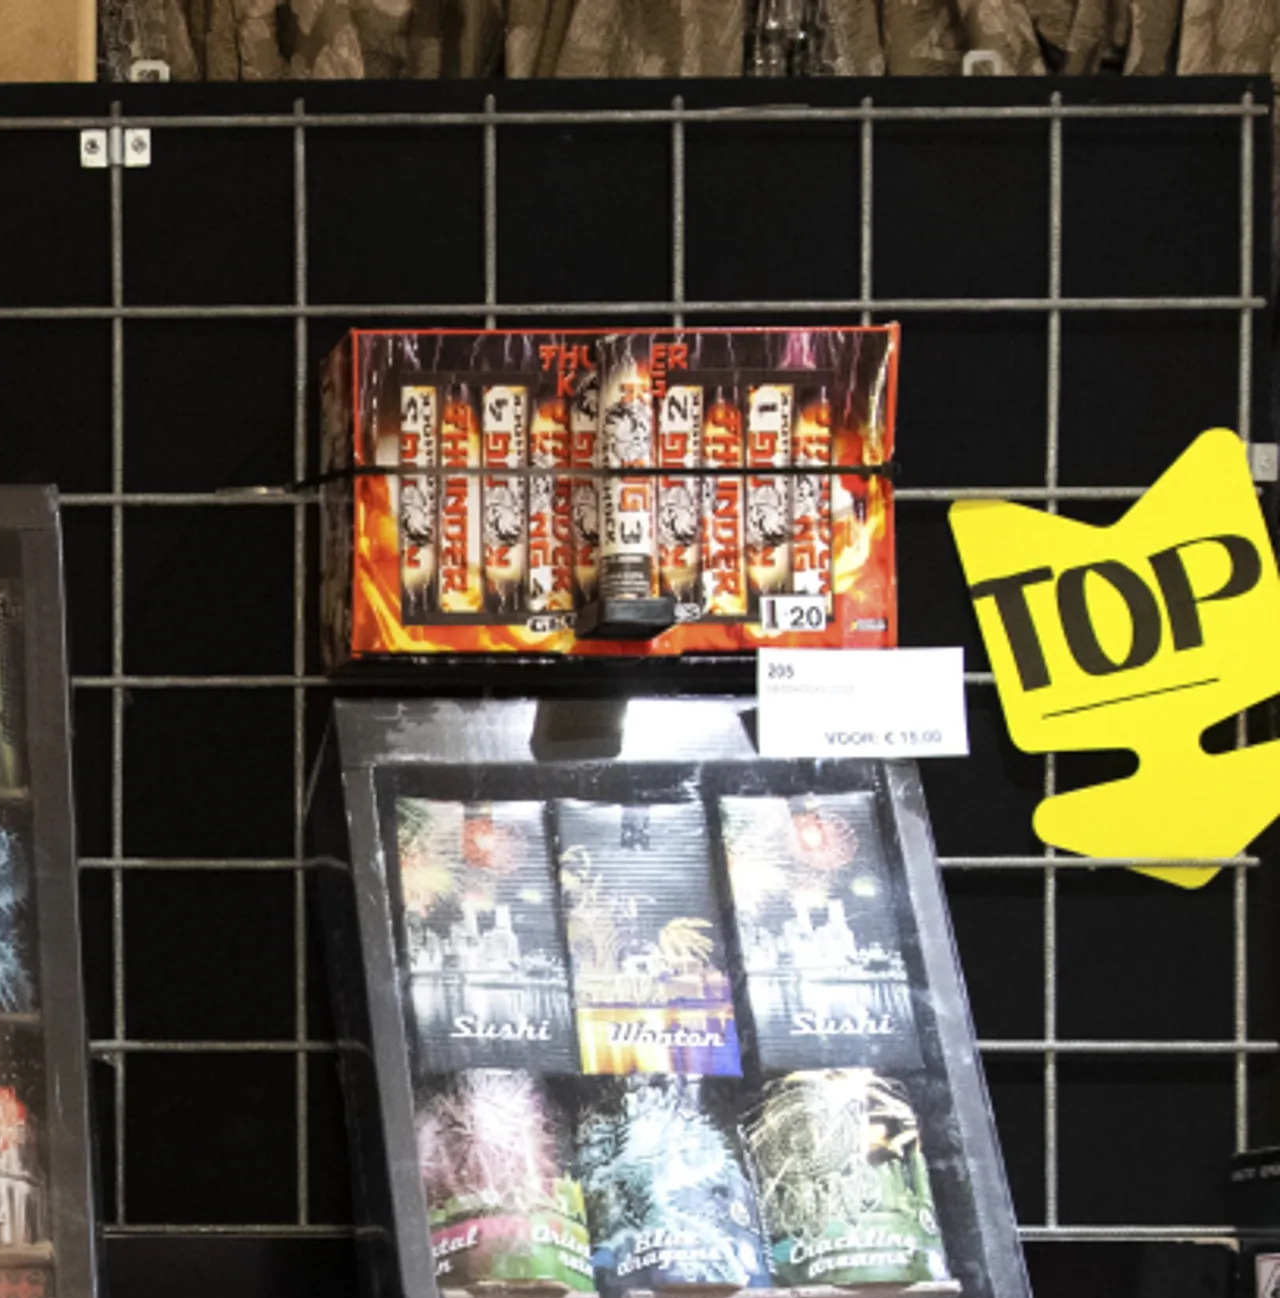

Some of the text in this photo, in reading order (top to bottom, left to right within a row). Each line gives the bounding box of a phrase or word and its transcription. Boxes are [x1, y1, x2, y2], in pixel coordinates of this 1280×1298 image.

[539, 344, 688, 371] THUER
[970, 534, 1262, 692] TOP
[450, 1016, 552, 1041] Sushi
[607, 1021, 725, 1047] Wonton
[790, 1011, 894, 1036] Sushi
[791, 1226, 918, 1264] Crackling
